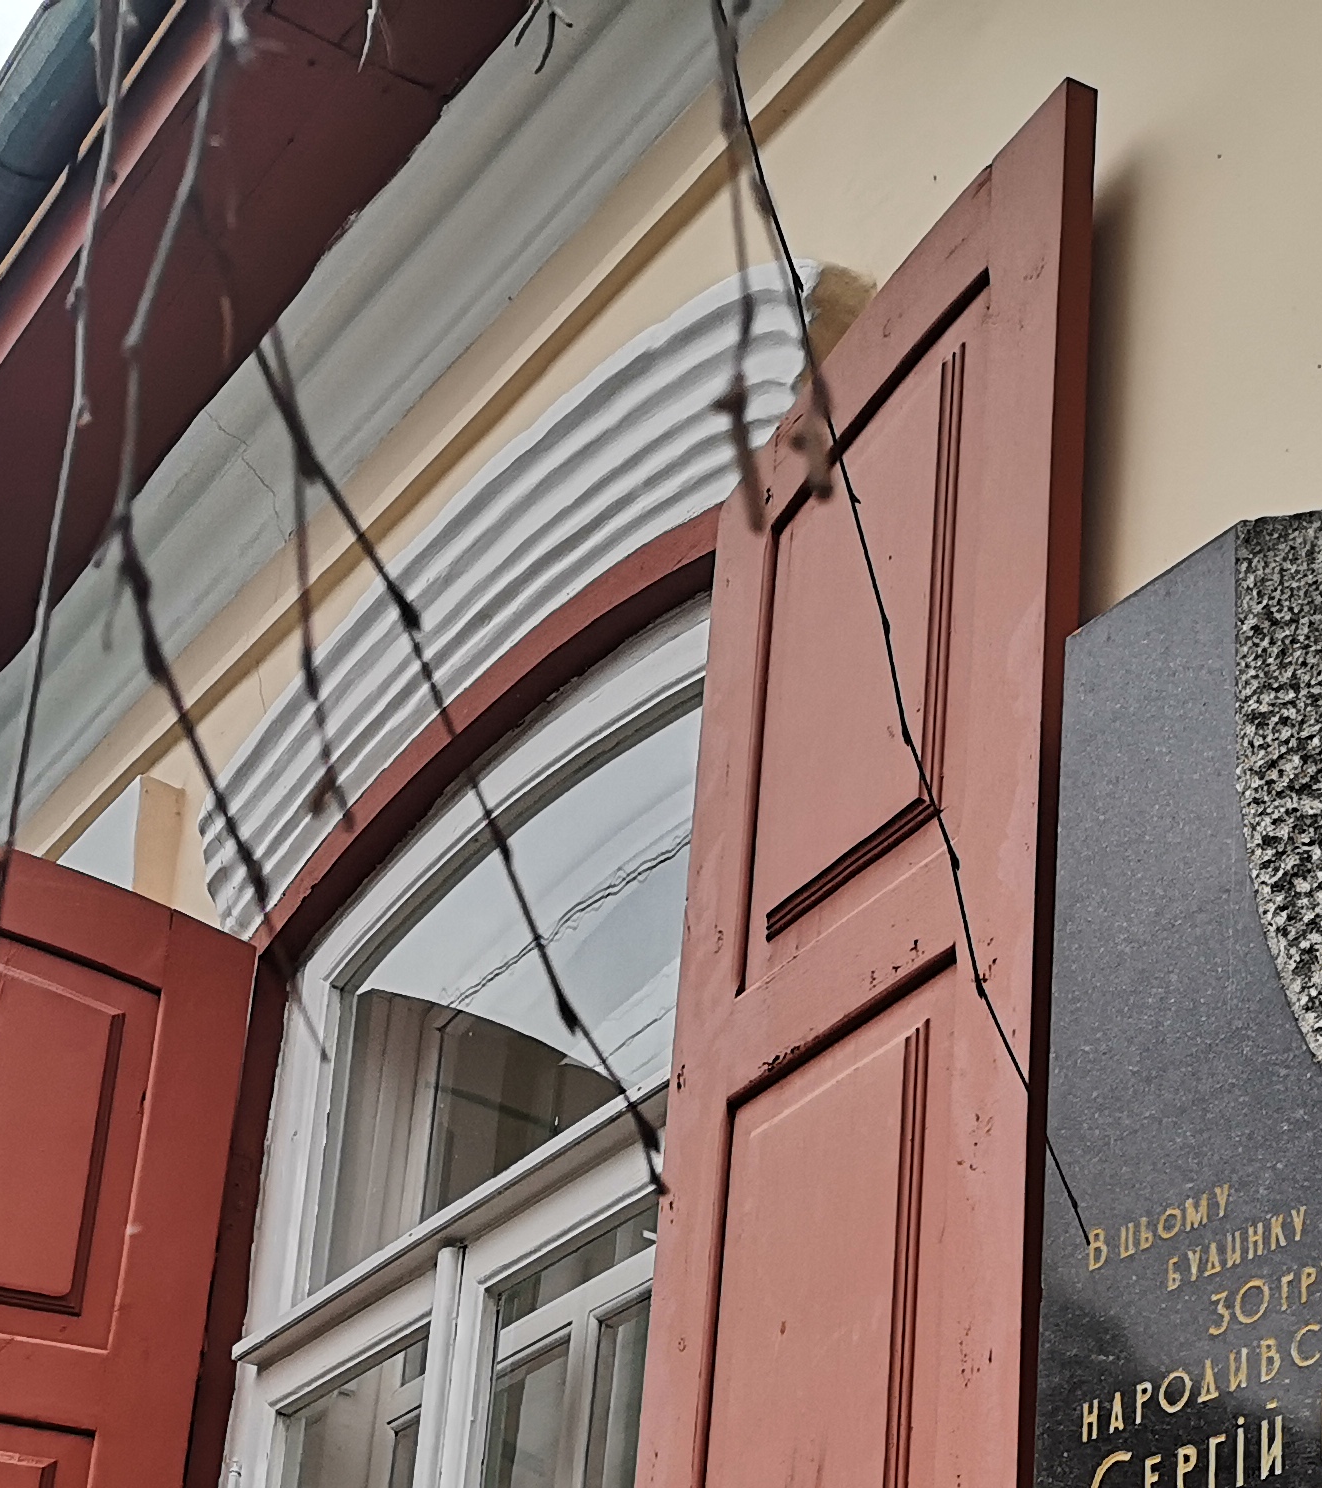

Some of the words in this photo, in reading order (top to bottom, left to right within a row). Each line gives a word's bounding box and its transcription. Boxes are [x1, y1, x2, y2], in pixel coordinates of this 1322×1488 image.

[1087, 1227, 1108, 1272] В
[1118, 1183, 1230, 1259] ЦЬОМУ
[1165, 1205, 1307, 1291] БУДИНКУ
[1209, 1276, 1269, 1335] 30
